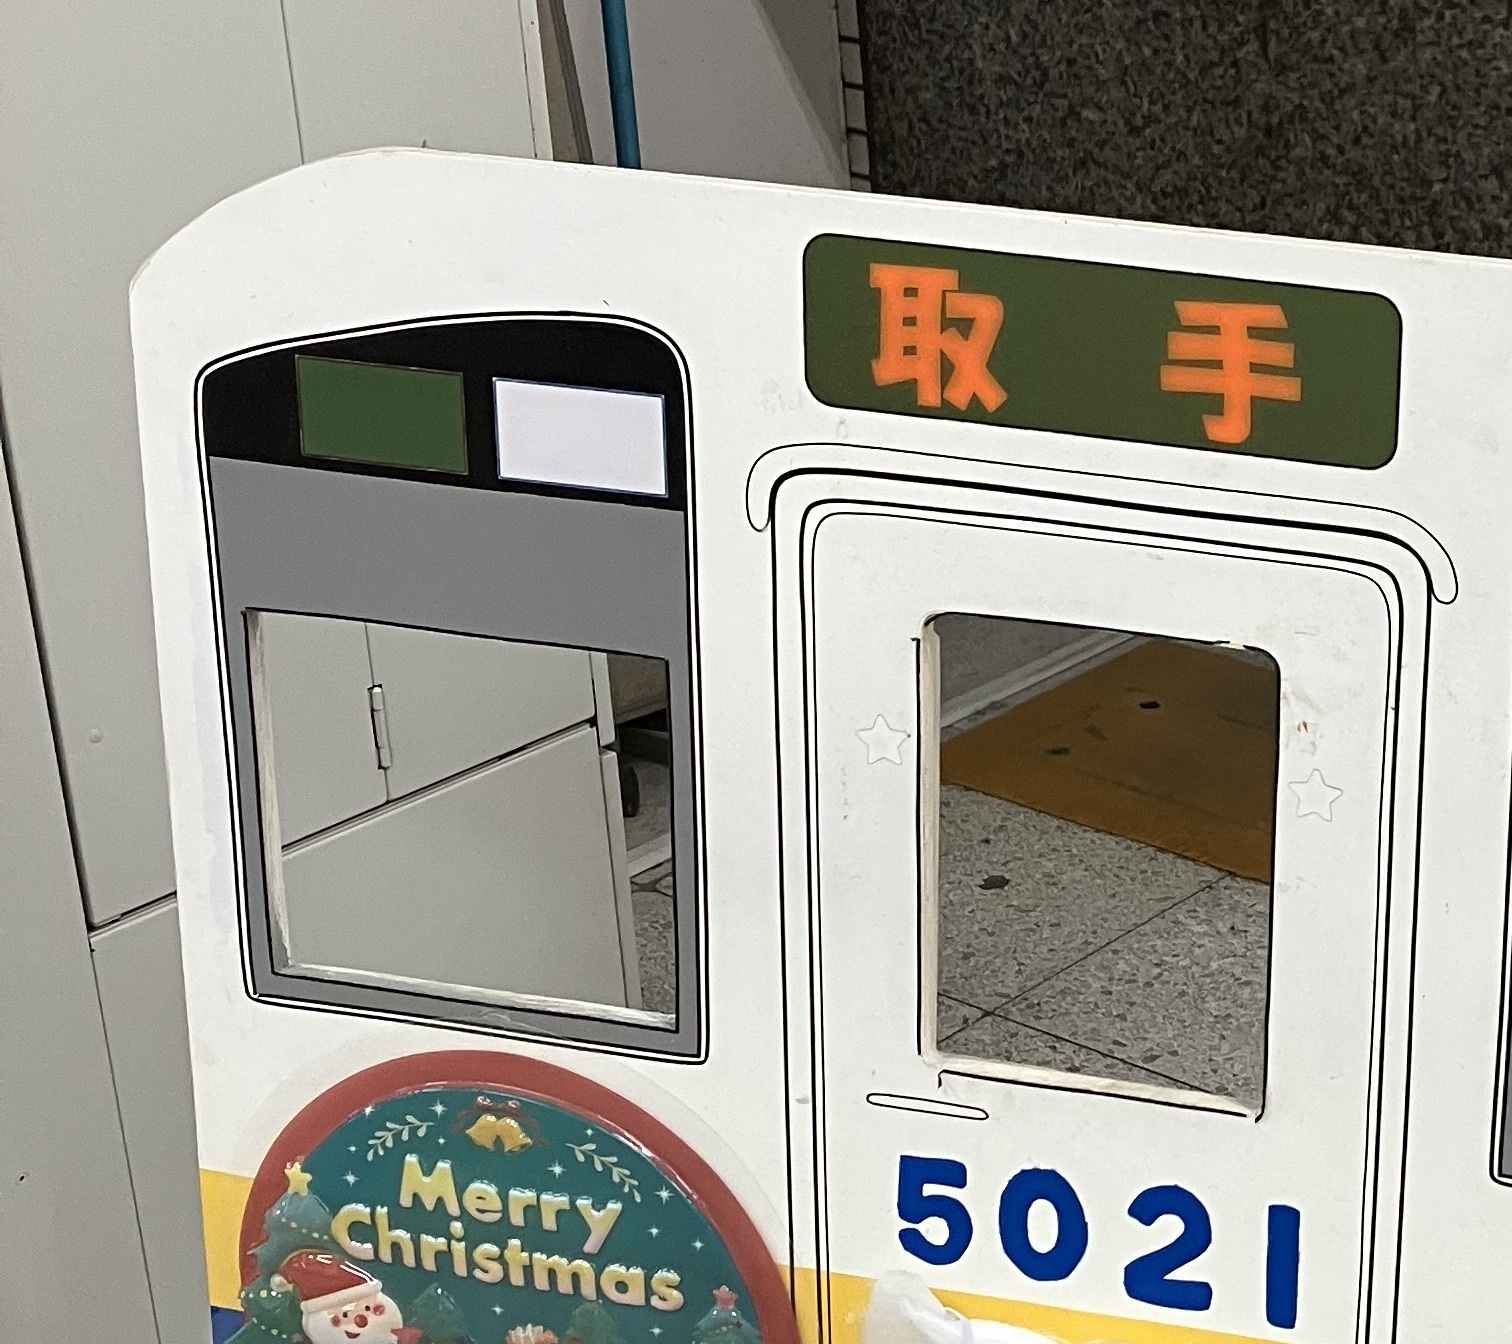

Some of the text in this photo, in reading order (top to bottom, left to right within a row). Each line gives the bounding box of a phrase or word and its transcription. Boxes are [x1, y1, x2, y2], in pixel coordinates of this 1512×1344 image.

[868, 262, 1302, 445] 取手
[330, 1202, 686, 1313] Christmas
[398, 1152, 624, 1255] Merry
[896, 1154, 1301, 1330] 5021
